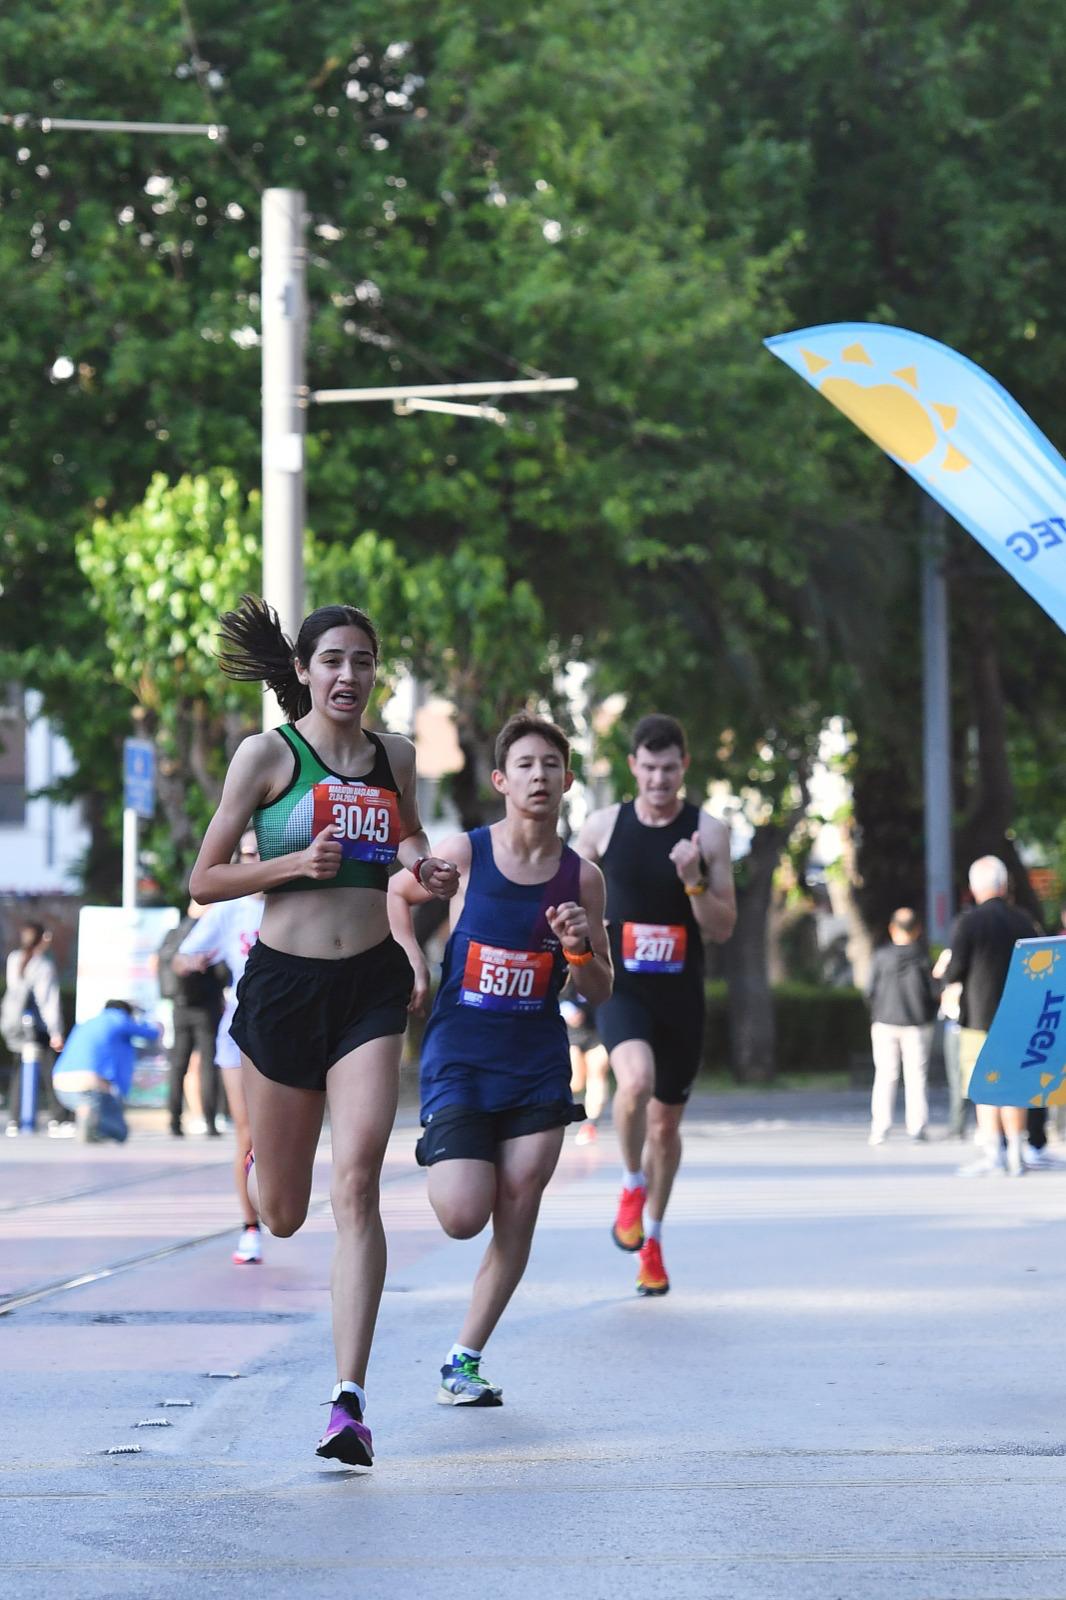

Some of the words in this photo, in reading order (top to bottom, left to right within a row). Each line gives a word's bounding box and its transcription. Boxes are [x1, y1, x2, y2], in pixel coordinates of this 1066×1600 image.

[332, 803, 390, 843] 3043
[635, 937, 675, 962] 2377
[479, 963, 535, 998] 5370
